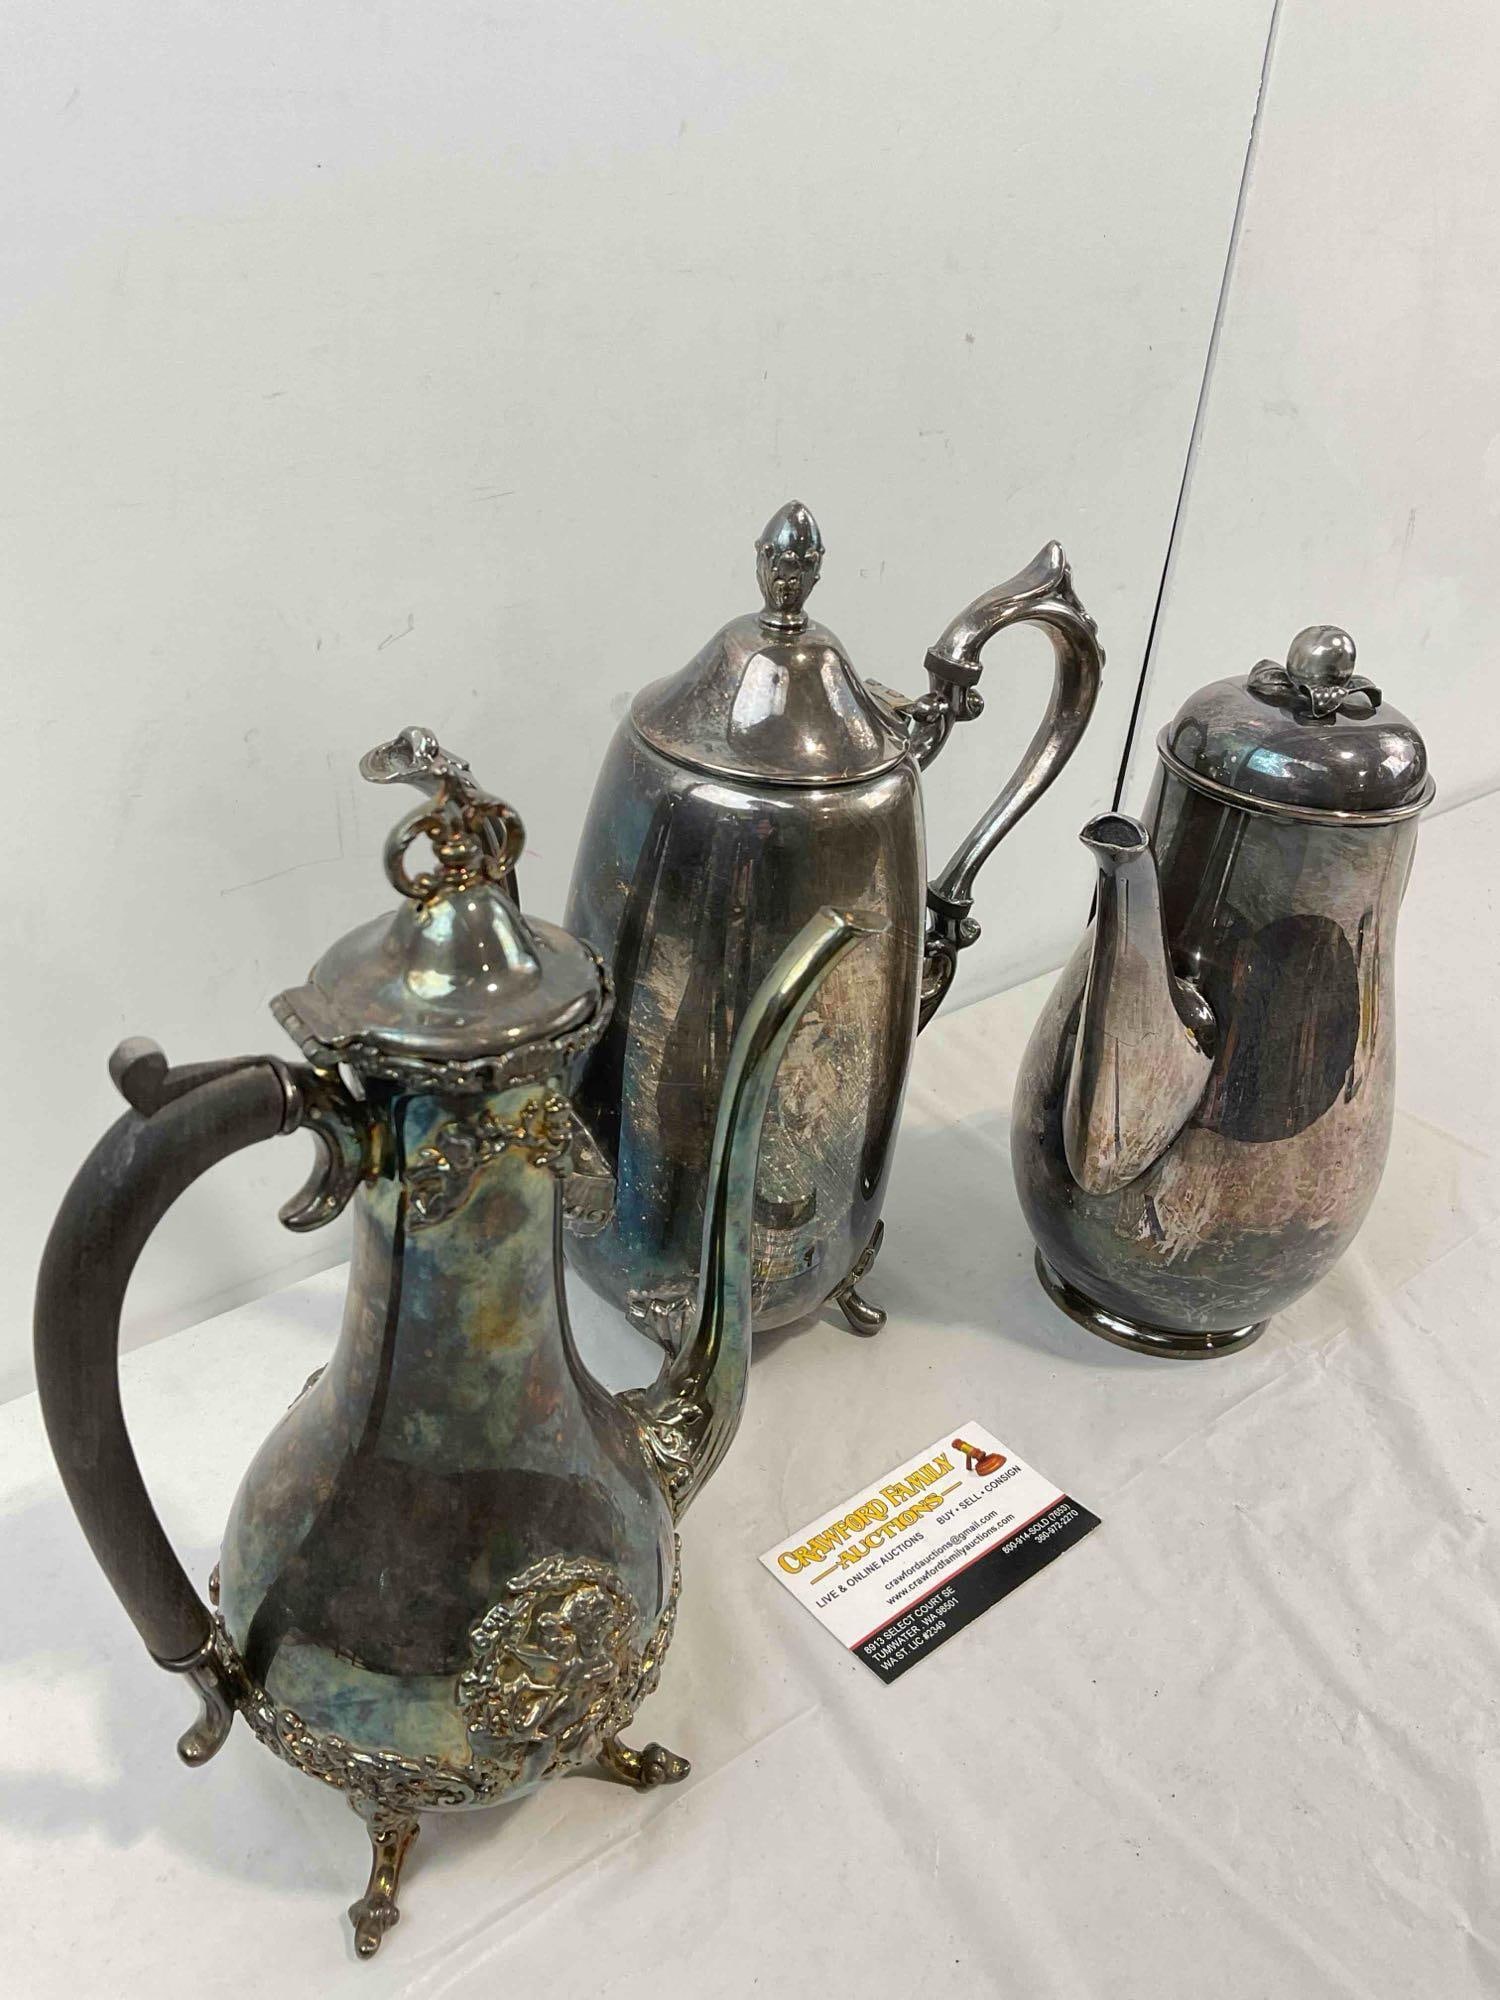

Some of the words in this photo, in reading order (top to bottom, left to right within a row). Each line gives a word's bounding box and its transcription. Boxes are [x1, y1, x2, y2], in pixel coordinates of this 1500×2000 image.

[777, 1498, 889, 1574] CRAWFORD
[879, 1452, 955, 1507] FAMILY
[936, 1510, 956, 1525] BUY
[959, 1493, 982, 1511] SELL
[984, 1465, 1021, 1493] CONSIGN
[1034, 1509, 1079, 1543] 360-972-2270
[836, 1492, 944, 1570] AUCTIONS
[884, 1509, 999, 1591] crawfordauctions@gmail.com
[886, 1513, 1016, 1606] www.crawfordfamilyauctions.com
[1001, 1518, 1050, 1554] 800-914-SOLD
[1048, 1503, 1071, 1521] (7653)
[815, 1592, 838, 1609] LIVE
[838, 1584, 847, 1593] &
[847, 1562, 881, 1587] ONLINE
[880, 1532, 924, 1567] AUCTIONS
[871, 1625, 921, 1661] TUMWATER
[921, 1613, 938, 1626] WA
[935, 1597, 959, 1616] 98501
[883, 1613, 915, 1640] SELECT
[914, 1594, 943, 1617] COURT
[941, 1585, 956, 1598] SE
[880, 1657, 899, 1670] WA
[895, 1647, 911, 1660] ST.
[907, 1637, 924, 1650] LIC
